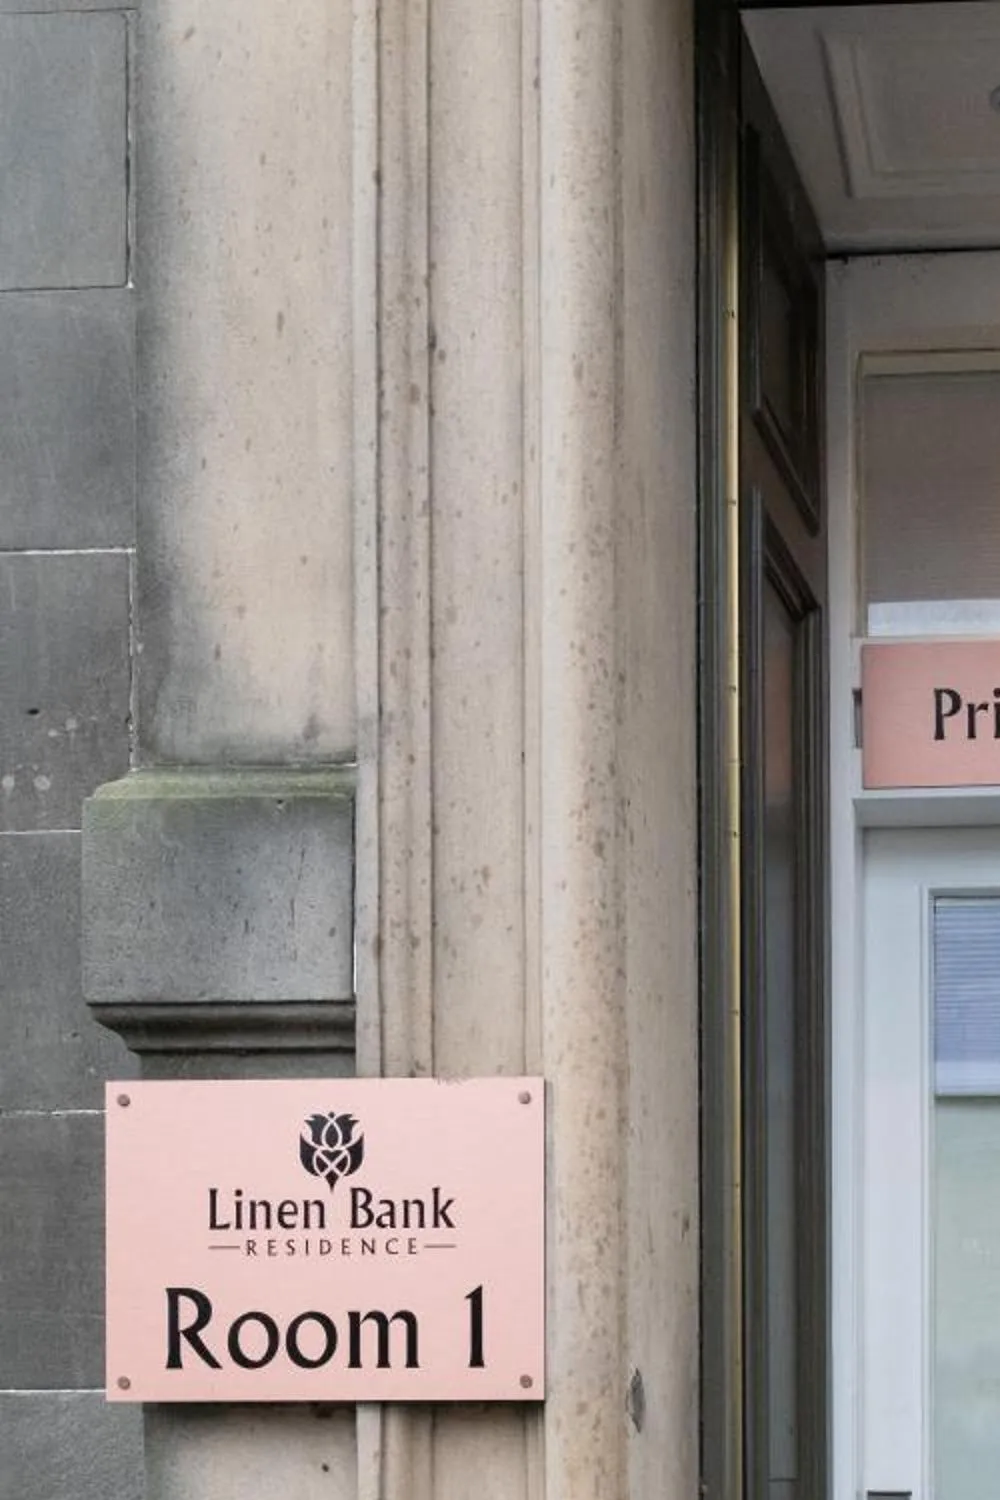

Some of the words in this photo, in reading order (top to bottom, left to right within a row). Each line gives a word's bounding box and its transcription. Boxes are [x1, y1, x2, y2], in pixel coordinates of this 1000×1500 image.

[209, 1188, 326, 1230] Linen
[350, 1187, 456, 1230] Bank
[246, 1237, 418, 1256] RESIDENCE
[165, 1287, 420, 1370] Room
[465, 1284, 486, 1369] 1
